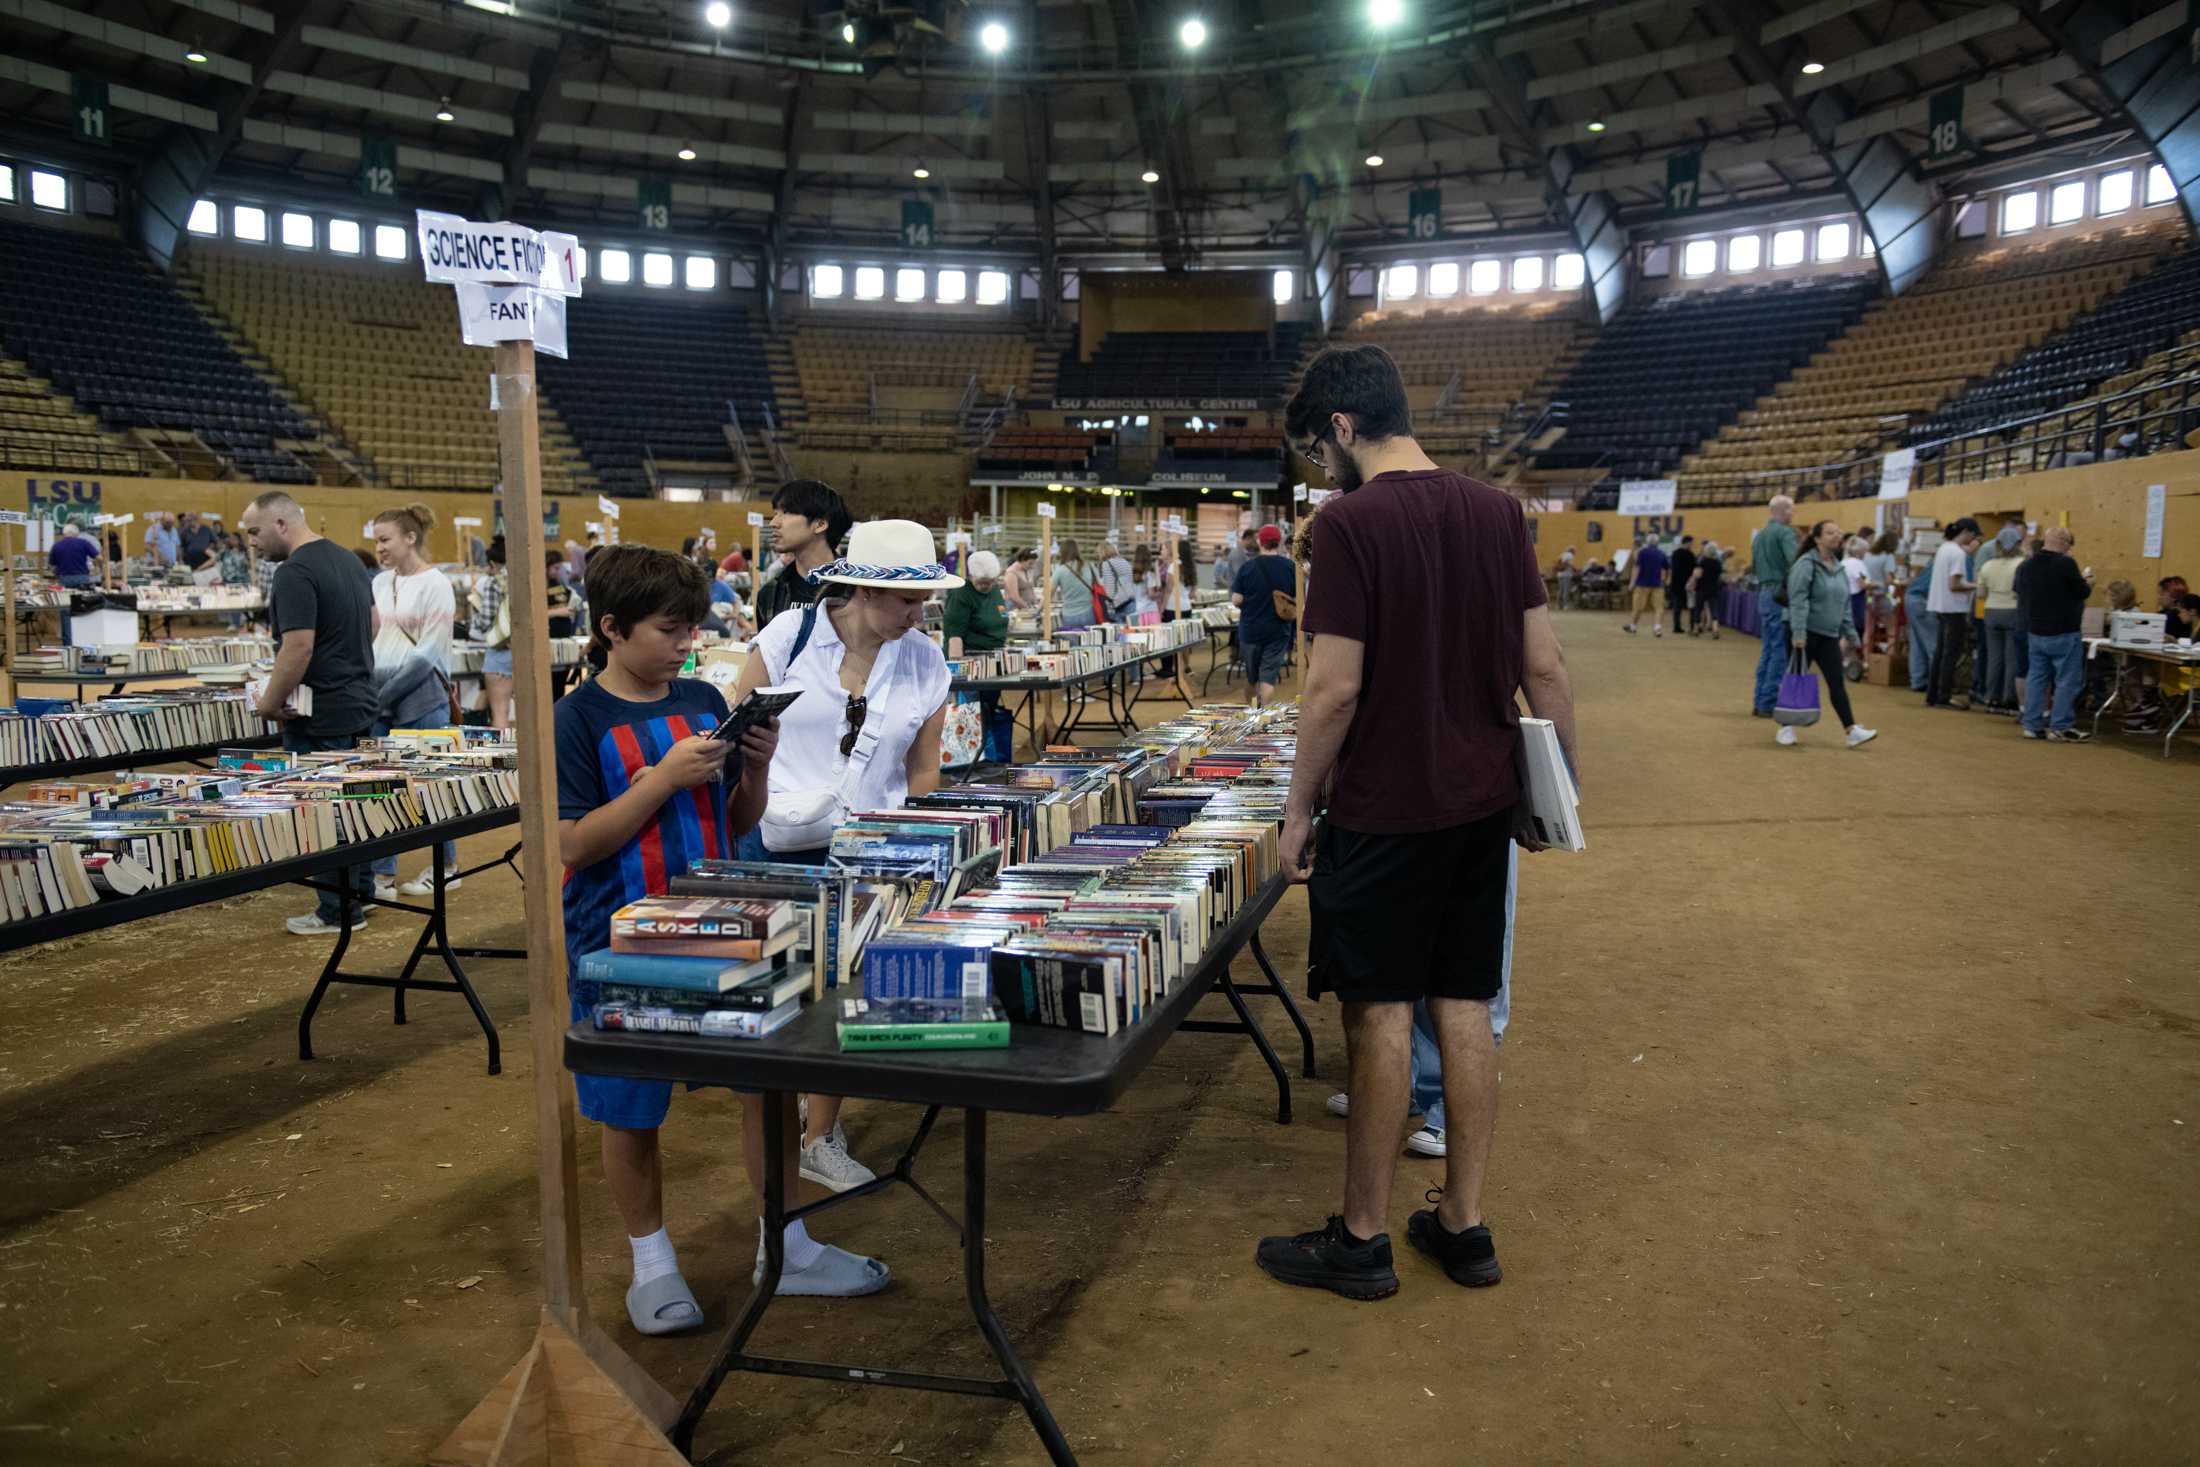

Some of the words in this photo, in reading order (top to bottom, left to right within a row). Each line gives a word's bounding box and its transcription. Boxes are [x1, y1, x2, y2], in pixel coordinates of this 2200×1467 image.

[80, 106, 104, 138] 11
[1931, 120, 1959, 153] 18
[366, 166, 394, 195] 12
[1670, 181, 1696, 208] 17
[642, 204, 668, 229] 13
[1413, 213, 1438, 237] 16
[905, 223, 929, 246] 14
[428, 229, 509, 271] SCIENCE
[564, 247, 575, 283] 1
[1052, 399, 1080, 409] LSU
[1086, 399, 1193, 409] AGRICULTURAL
[1200, 399, 1258, 409] CENTER
[1018, 471, 1056, 480] JOHN
[1152, 472, 1226, 481] COLISEUM
[27, 479, 102, 504] LSU
[1633, 515, 1684, 537] LSU
[615, 918, 743, 937] MASKED
